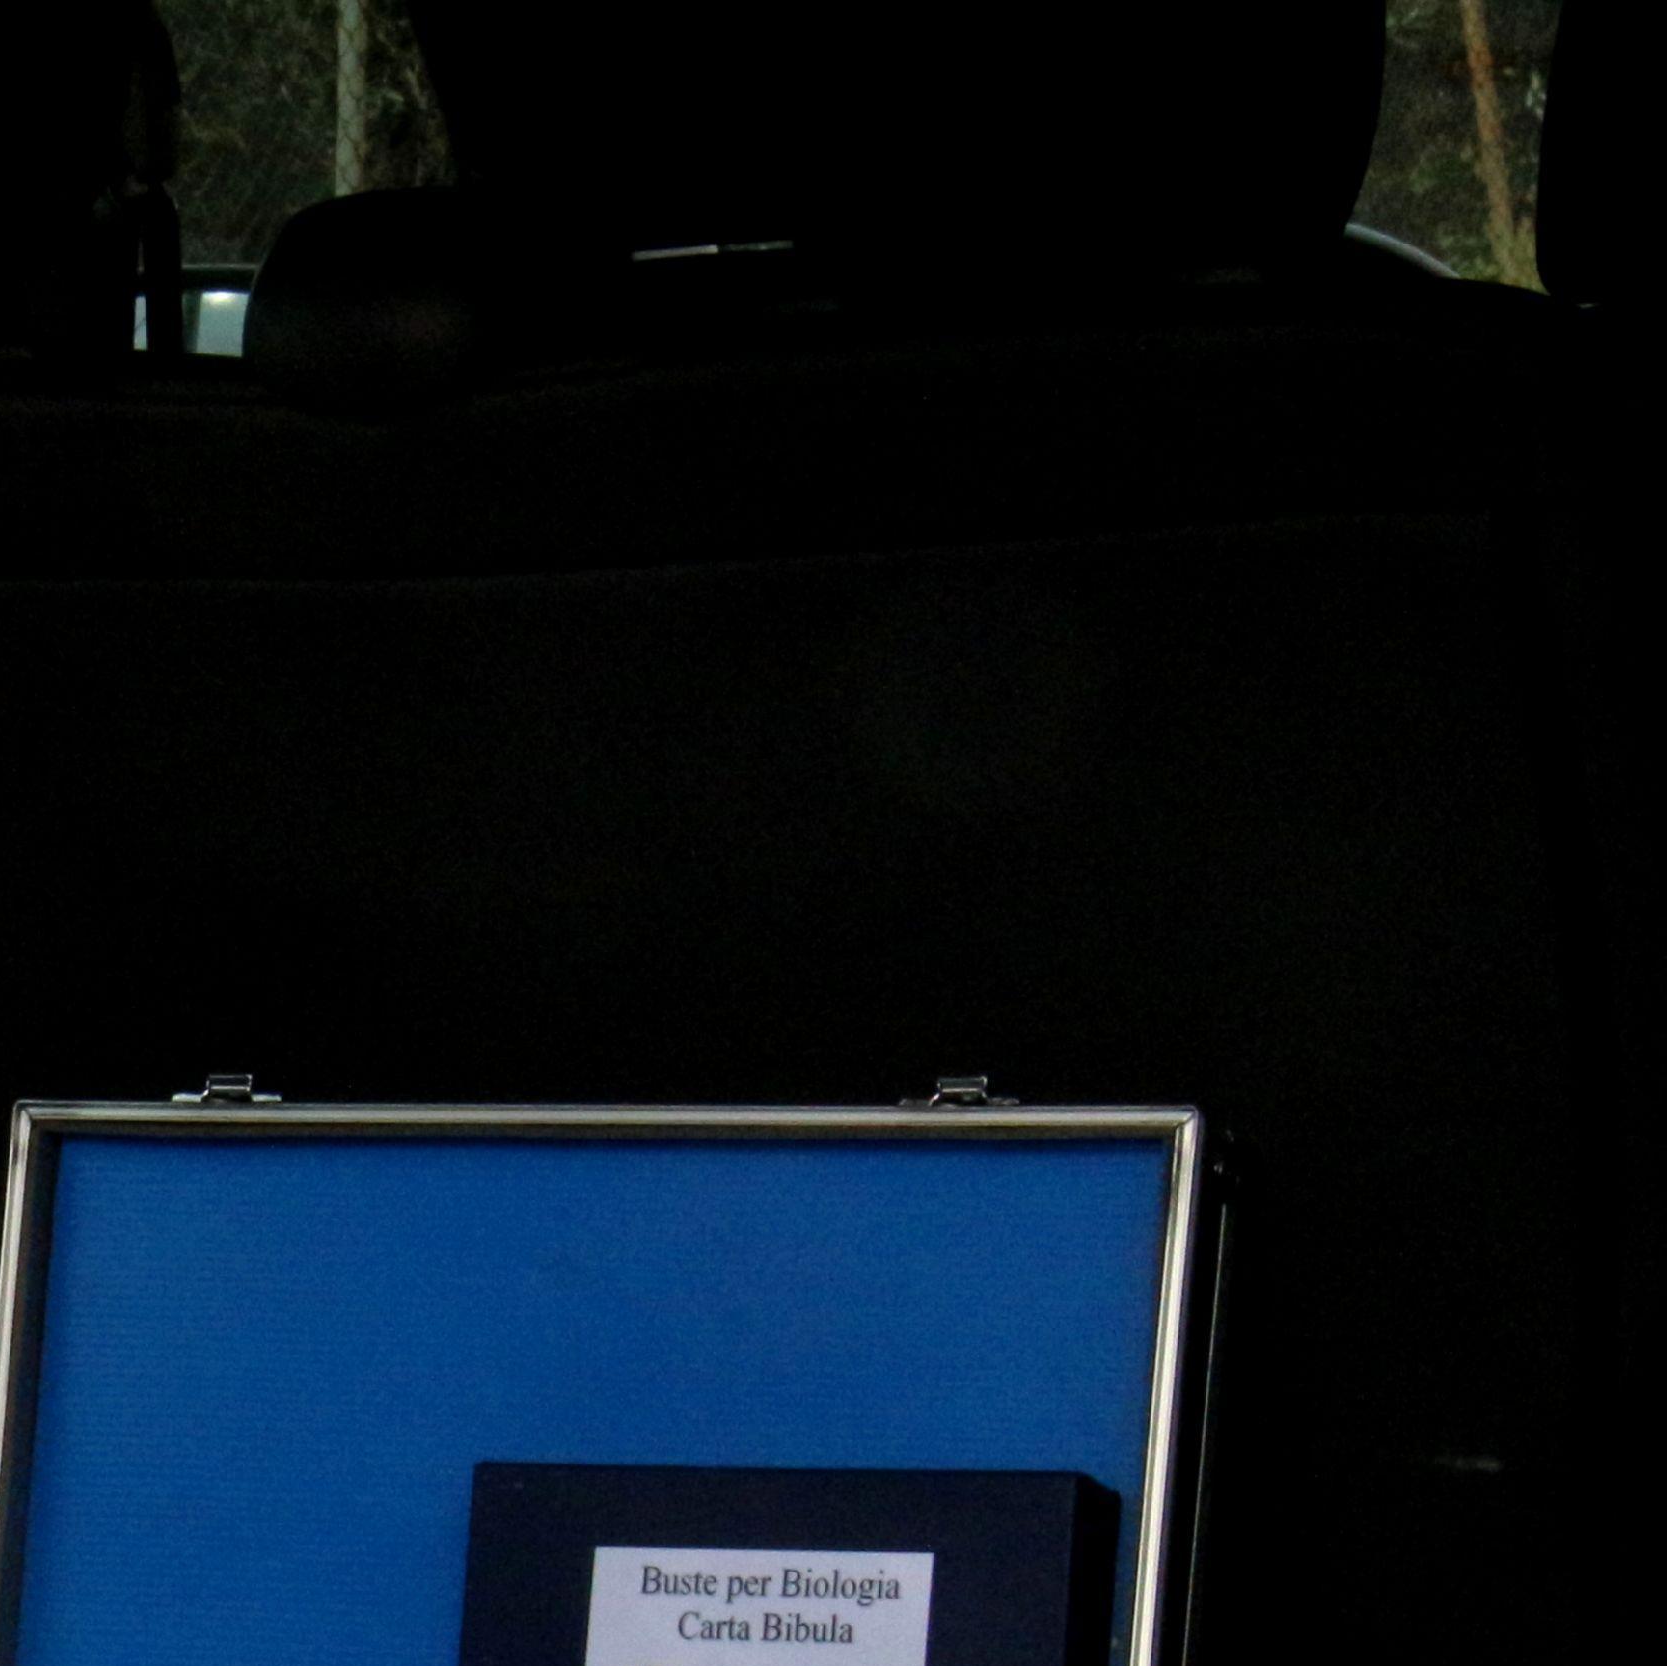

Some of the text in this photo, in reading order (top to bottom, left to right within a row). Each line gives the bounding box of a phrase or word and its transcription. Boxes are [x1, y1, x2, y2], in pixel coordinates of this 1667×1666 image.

[641, 1566, 900, 1606] Buste per Biologia
[678, 1611, 854, 1643] Carta Bibula
